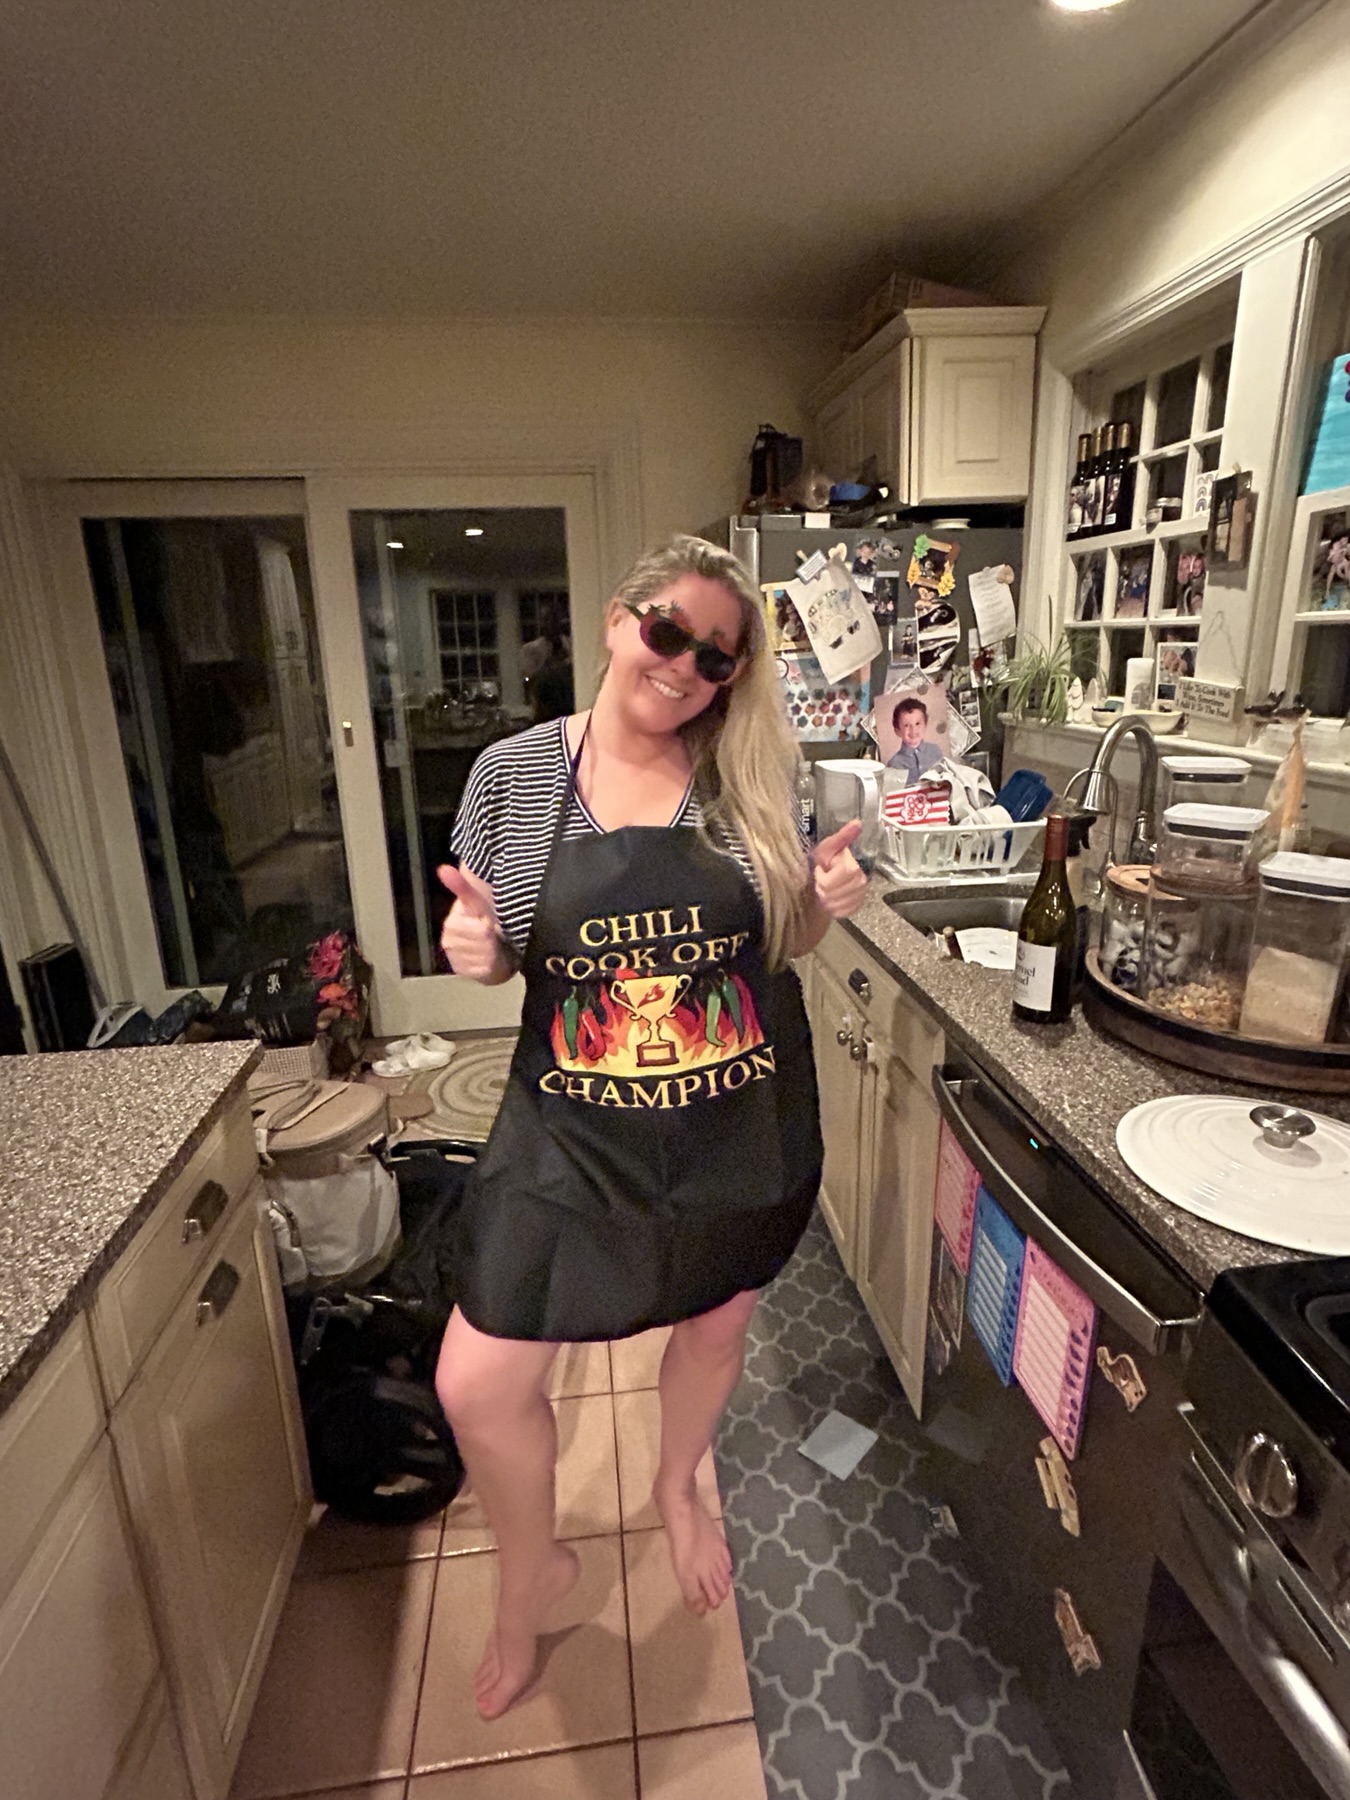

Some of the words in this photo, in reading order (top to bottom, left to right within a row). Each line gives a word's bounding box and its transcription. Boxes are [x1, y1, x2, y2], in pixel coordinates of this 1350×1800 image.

[1203, 686, 1216, 695] Cook
[579, 904, 704, 947] CHILI
[545, 947, 657, 980] COOK
[672, 931, 750, 964] OFF
[539, 1045, 777, 1109] CHAMPION
